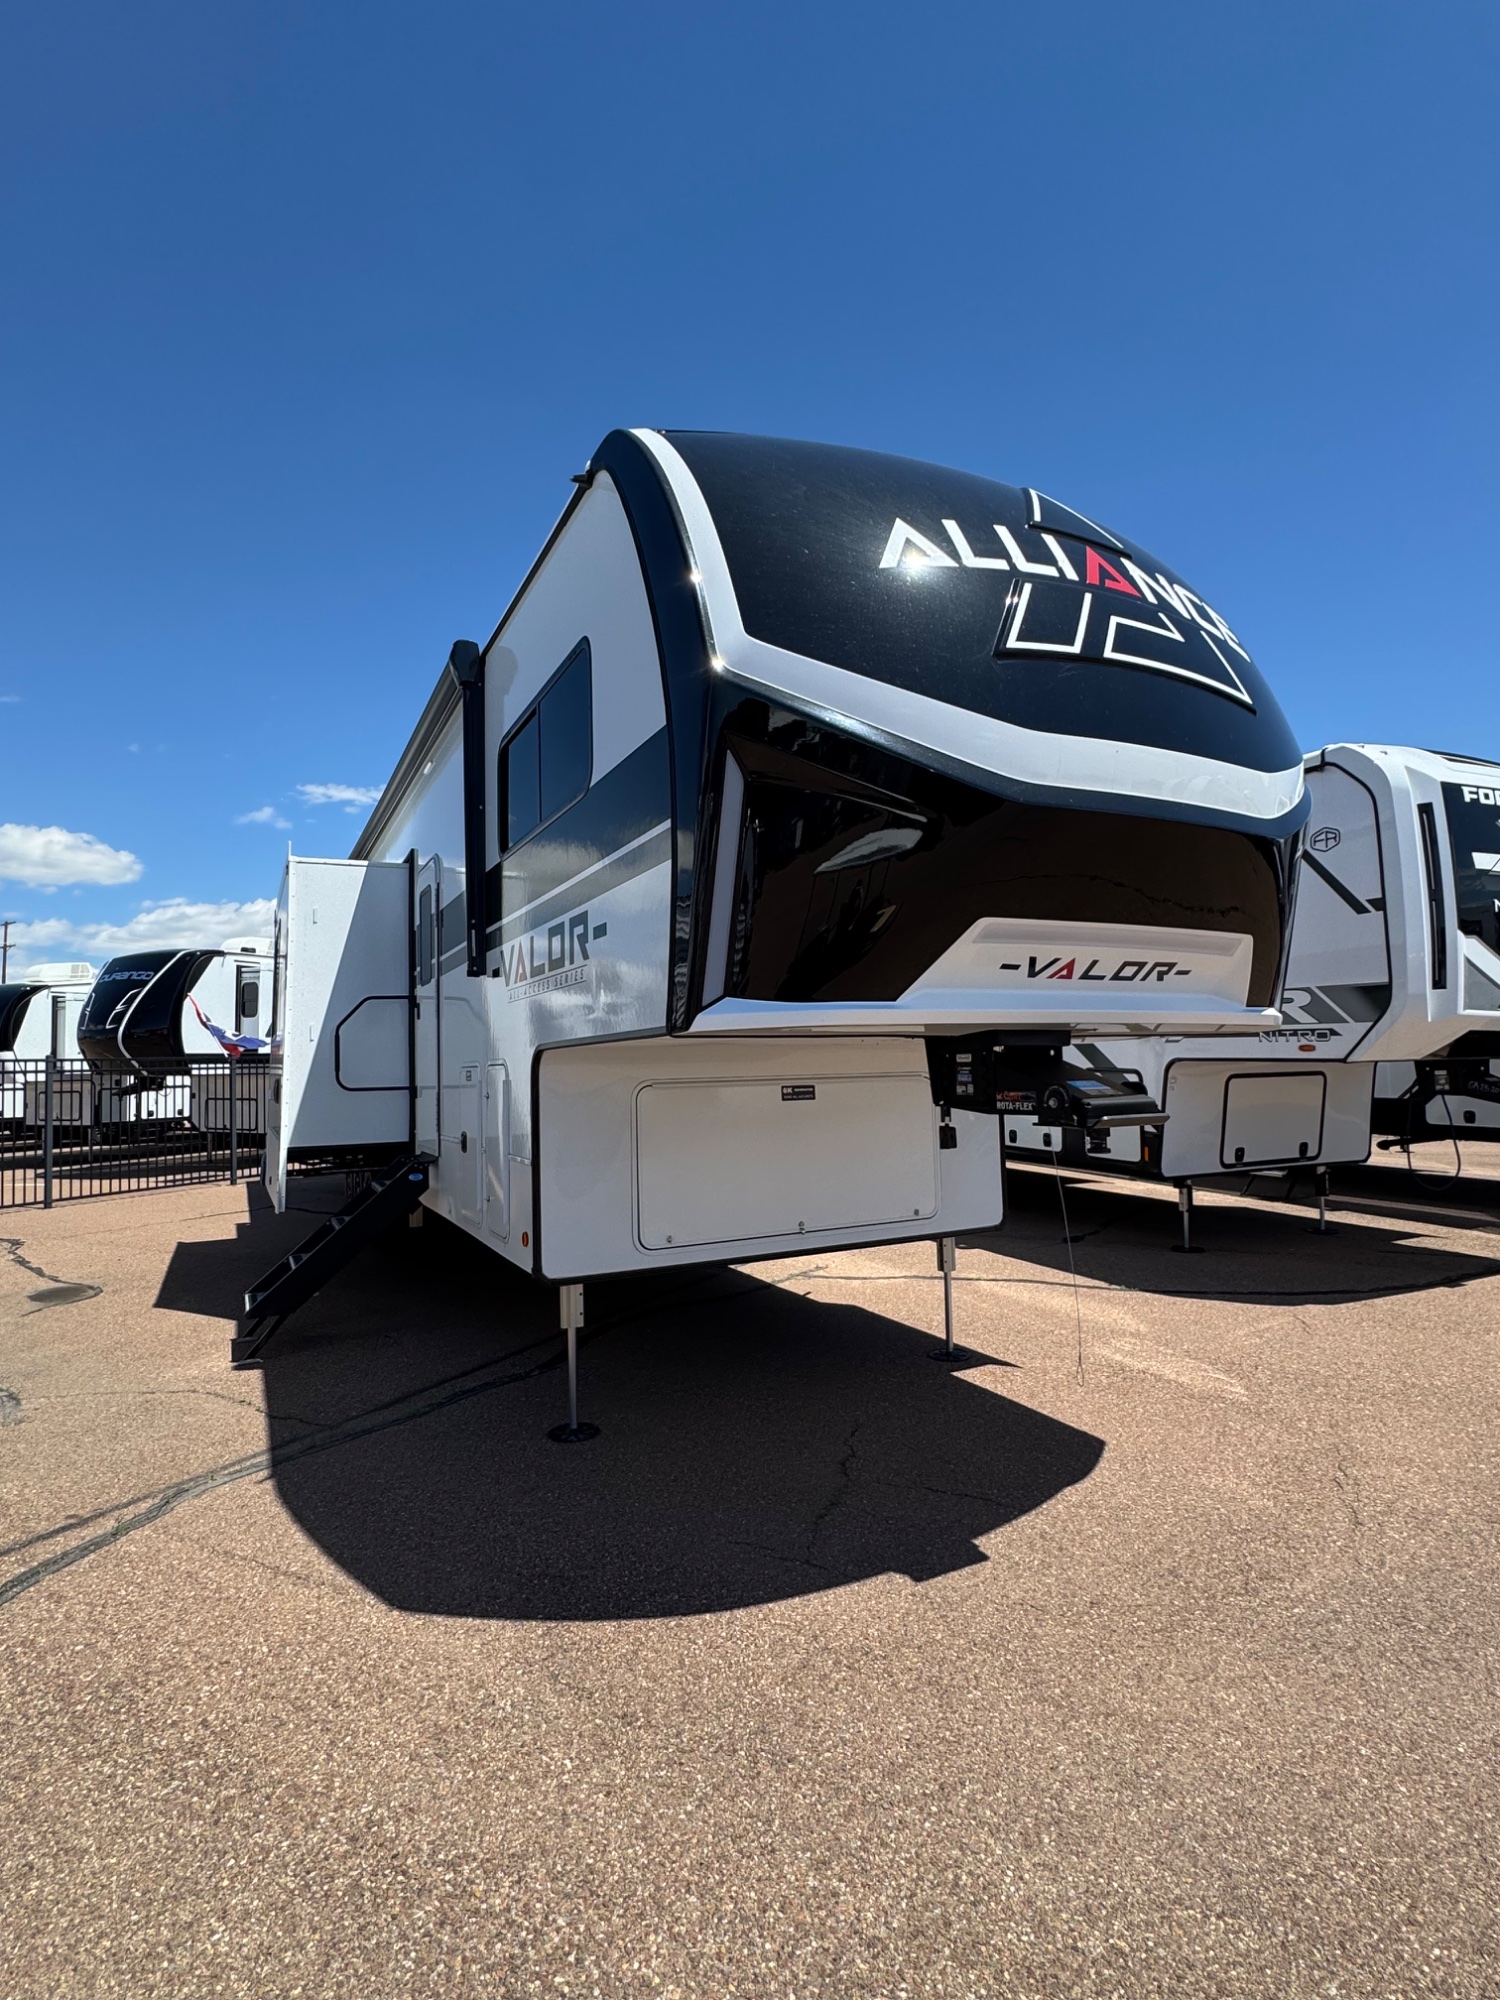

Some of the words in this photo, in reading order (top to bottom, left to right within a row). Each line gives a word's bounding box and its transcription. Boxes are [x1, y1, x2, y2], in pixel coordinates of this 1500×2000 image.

[879, 517, 1251, 663] ALLIANCE
[1461, 786, 1500, 806] FO
[508, 979, 550, 1001] ALL-ACCESS
[554, 968, 585, 988] SERIES
[1259, 1030, 1331, 1043] NITRO
